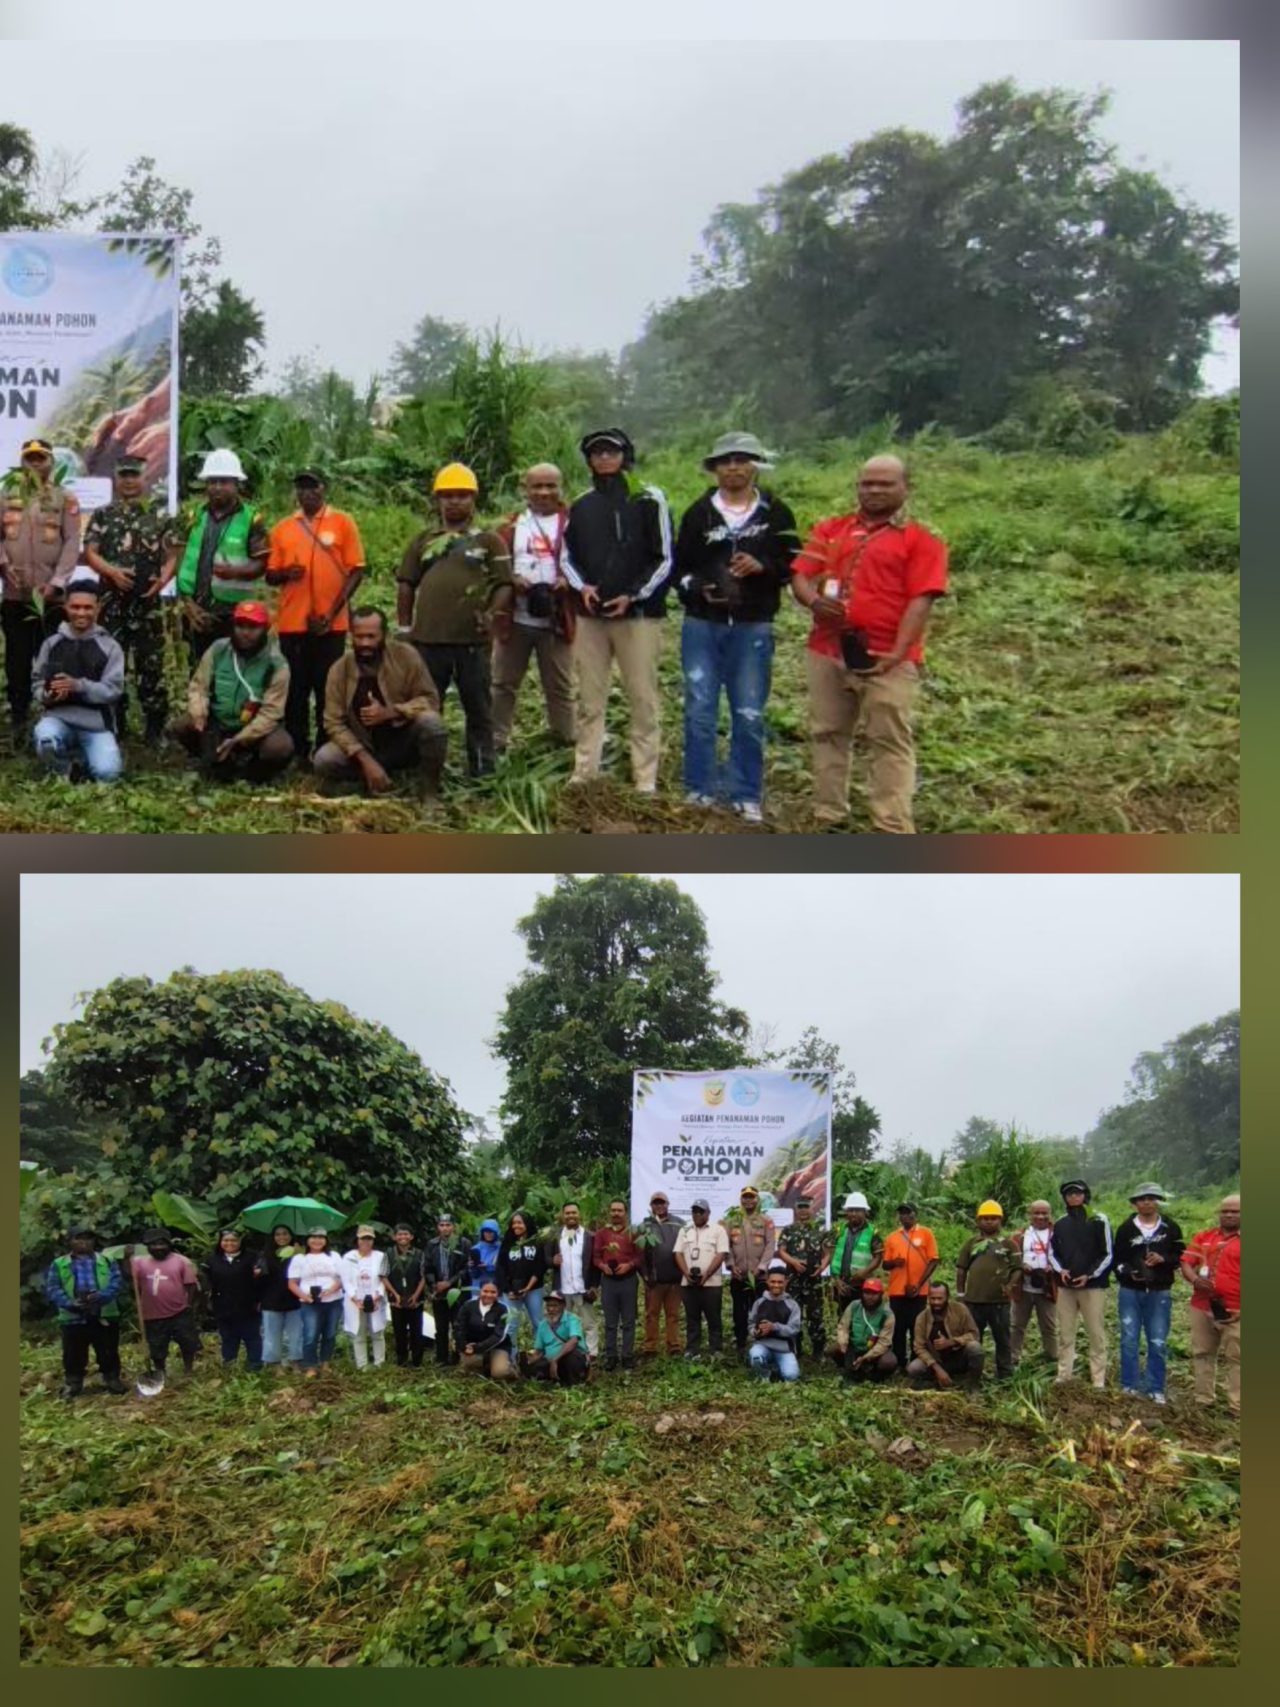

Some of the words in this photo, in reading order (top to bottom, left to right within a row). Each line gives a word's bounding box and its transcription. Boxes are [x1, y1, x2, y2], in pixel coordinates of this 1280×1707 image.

[56, 313, 96, 328] POHON
[662, 1145, 764, 1157] PENANAMAN
[662, 1157, 751, 1175] POHON
